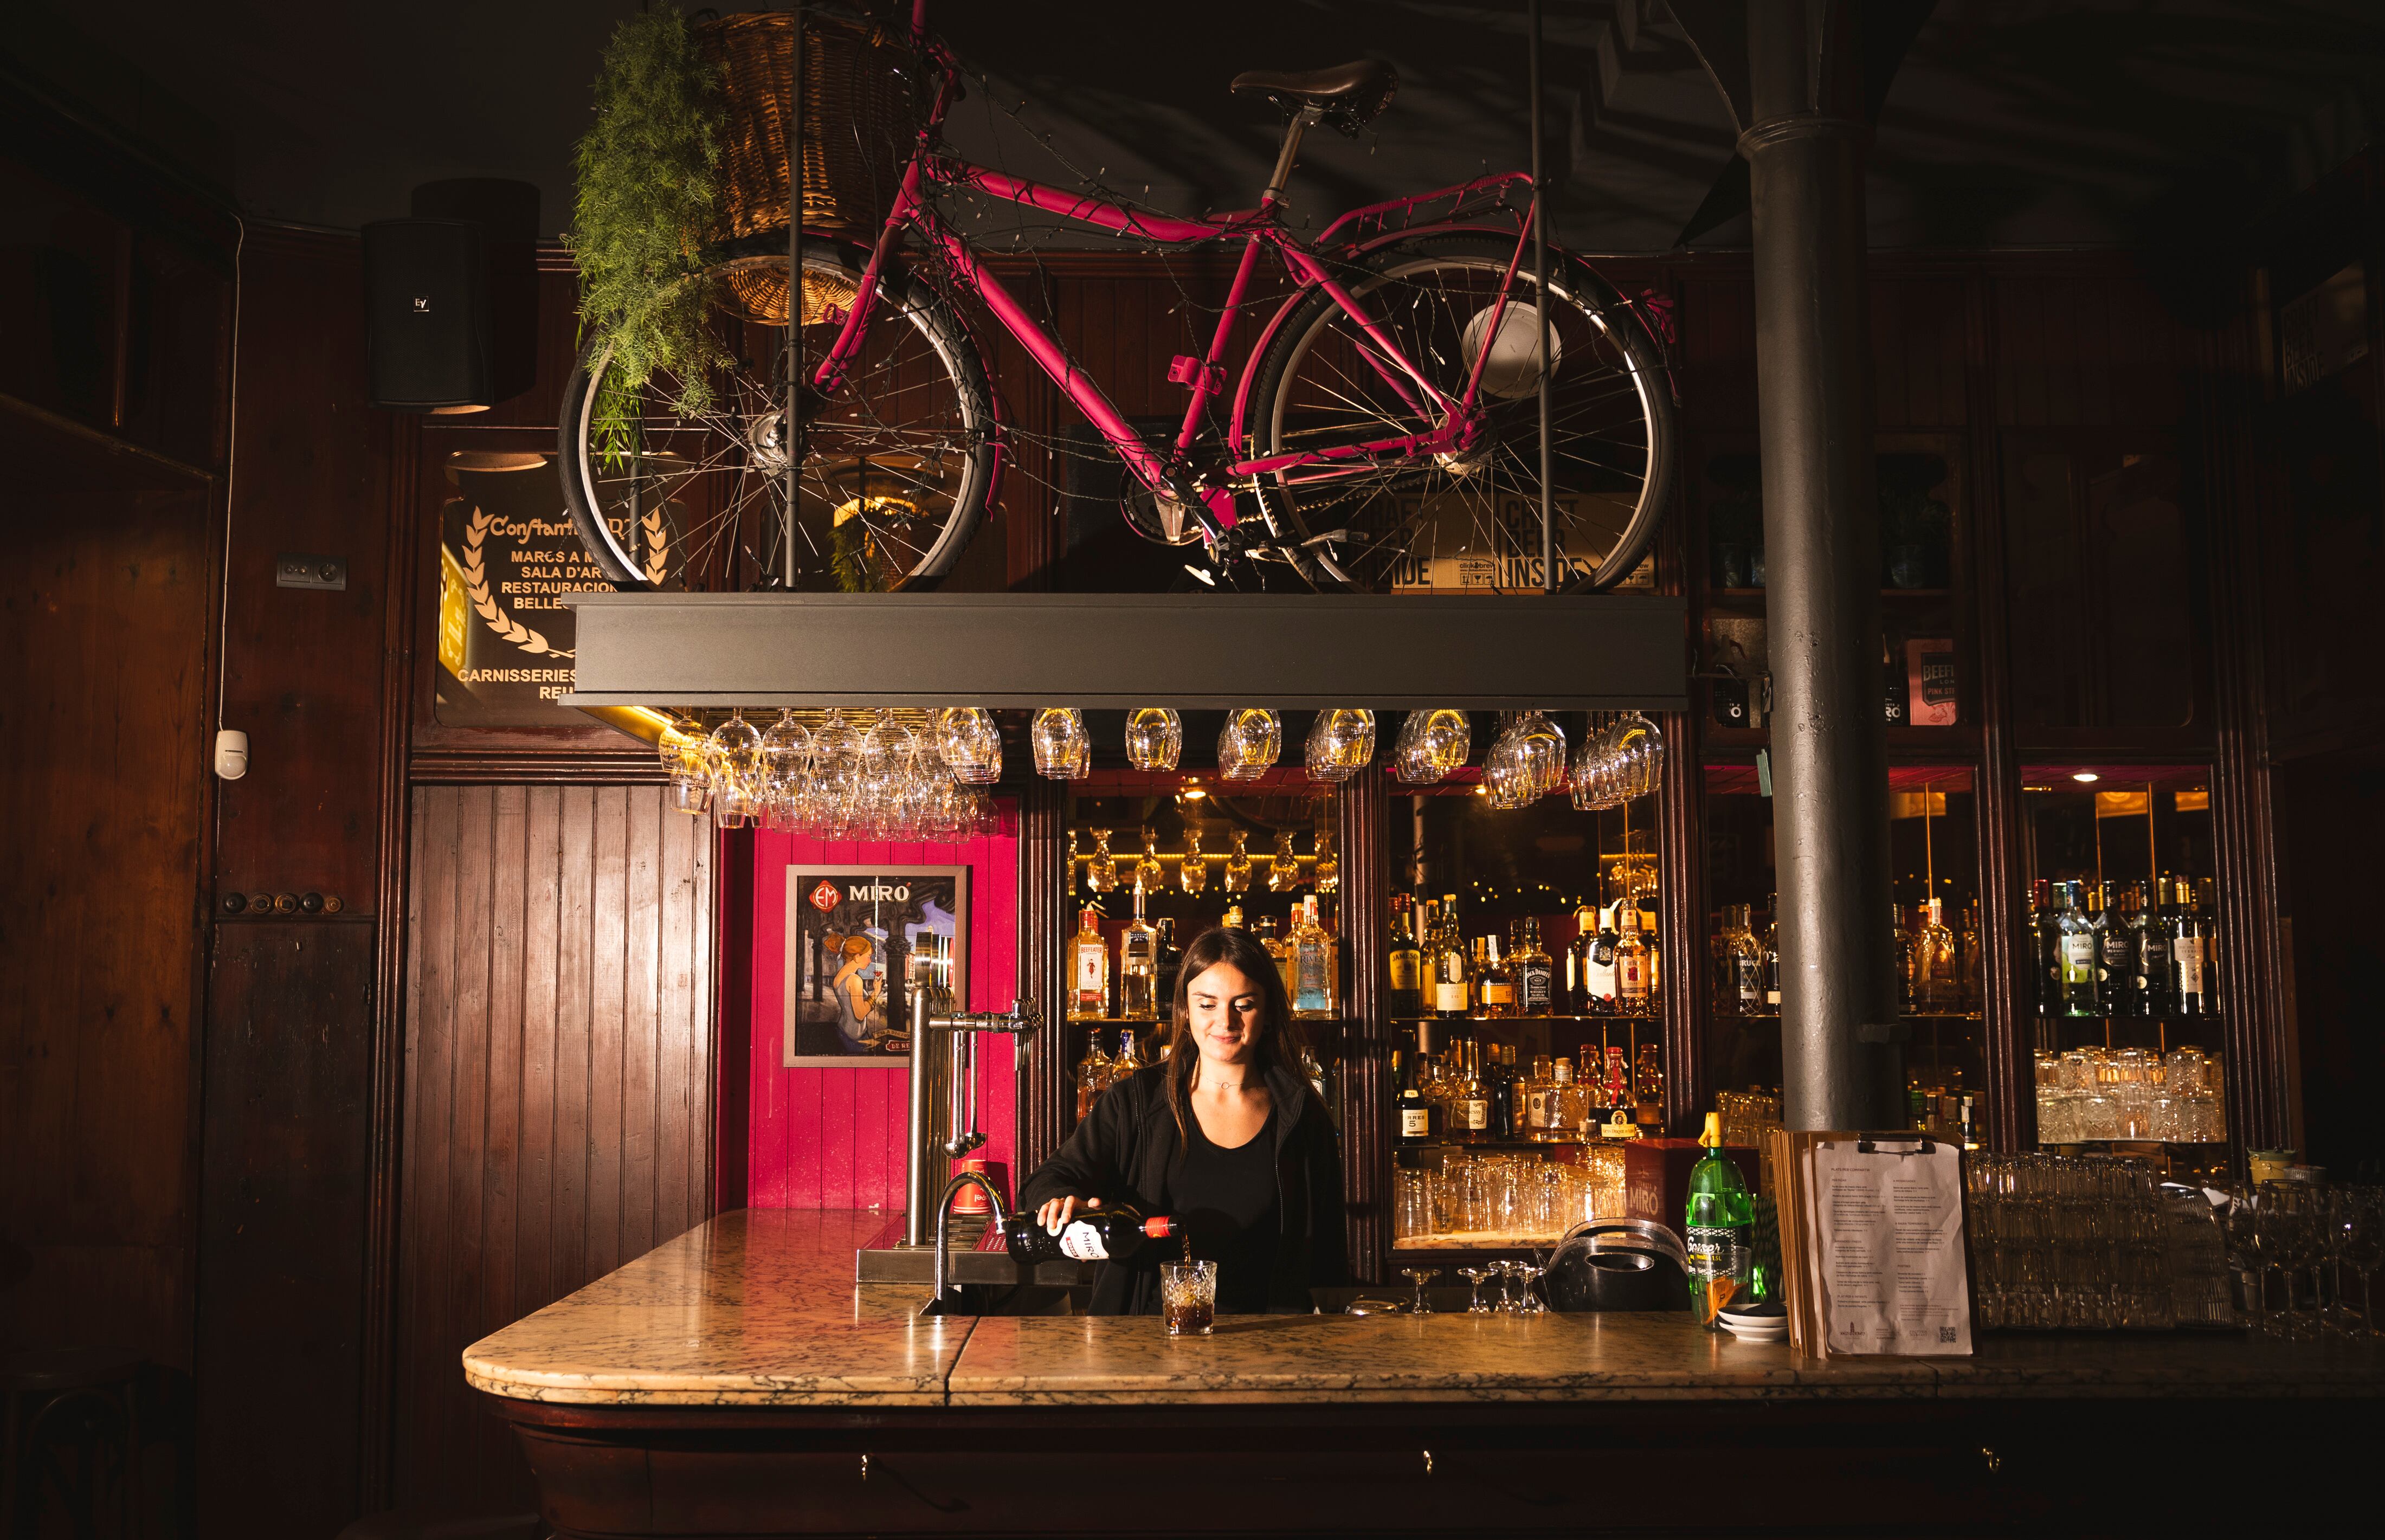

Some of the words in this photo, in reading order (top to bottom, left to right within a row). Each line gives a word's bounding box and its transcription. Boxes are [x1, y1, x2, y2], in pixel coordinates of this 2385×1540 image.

[415, 299, 427, 308] EV
[1506, 499, 1579, 529] CRT
[511, 551, 565, 563] MARCS
[569, 551, 580, 563] A
[521, 566, 551, 578] SALA
[556, 566, 602, 578] D'AR
[1507, 557, 1582, 587] INSDE
[501, 582, 618, 594] RESTAURACION
[539, 686, 573, 699] REU
[1300, 956, 1324, 964] RIVES
[1630, 1185, 1659, 1215] MIRÓ
